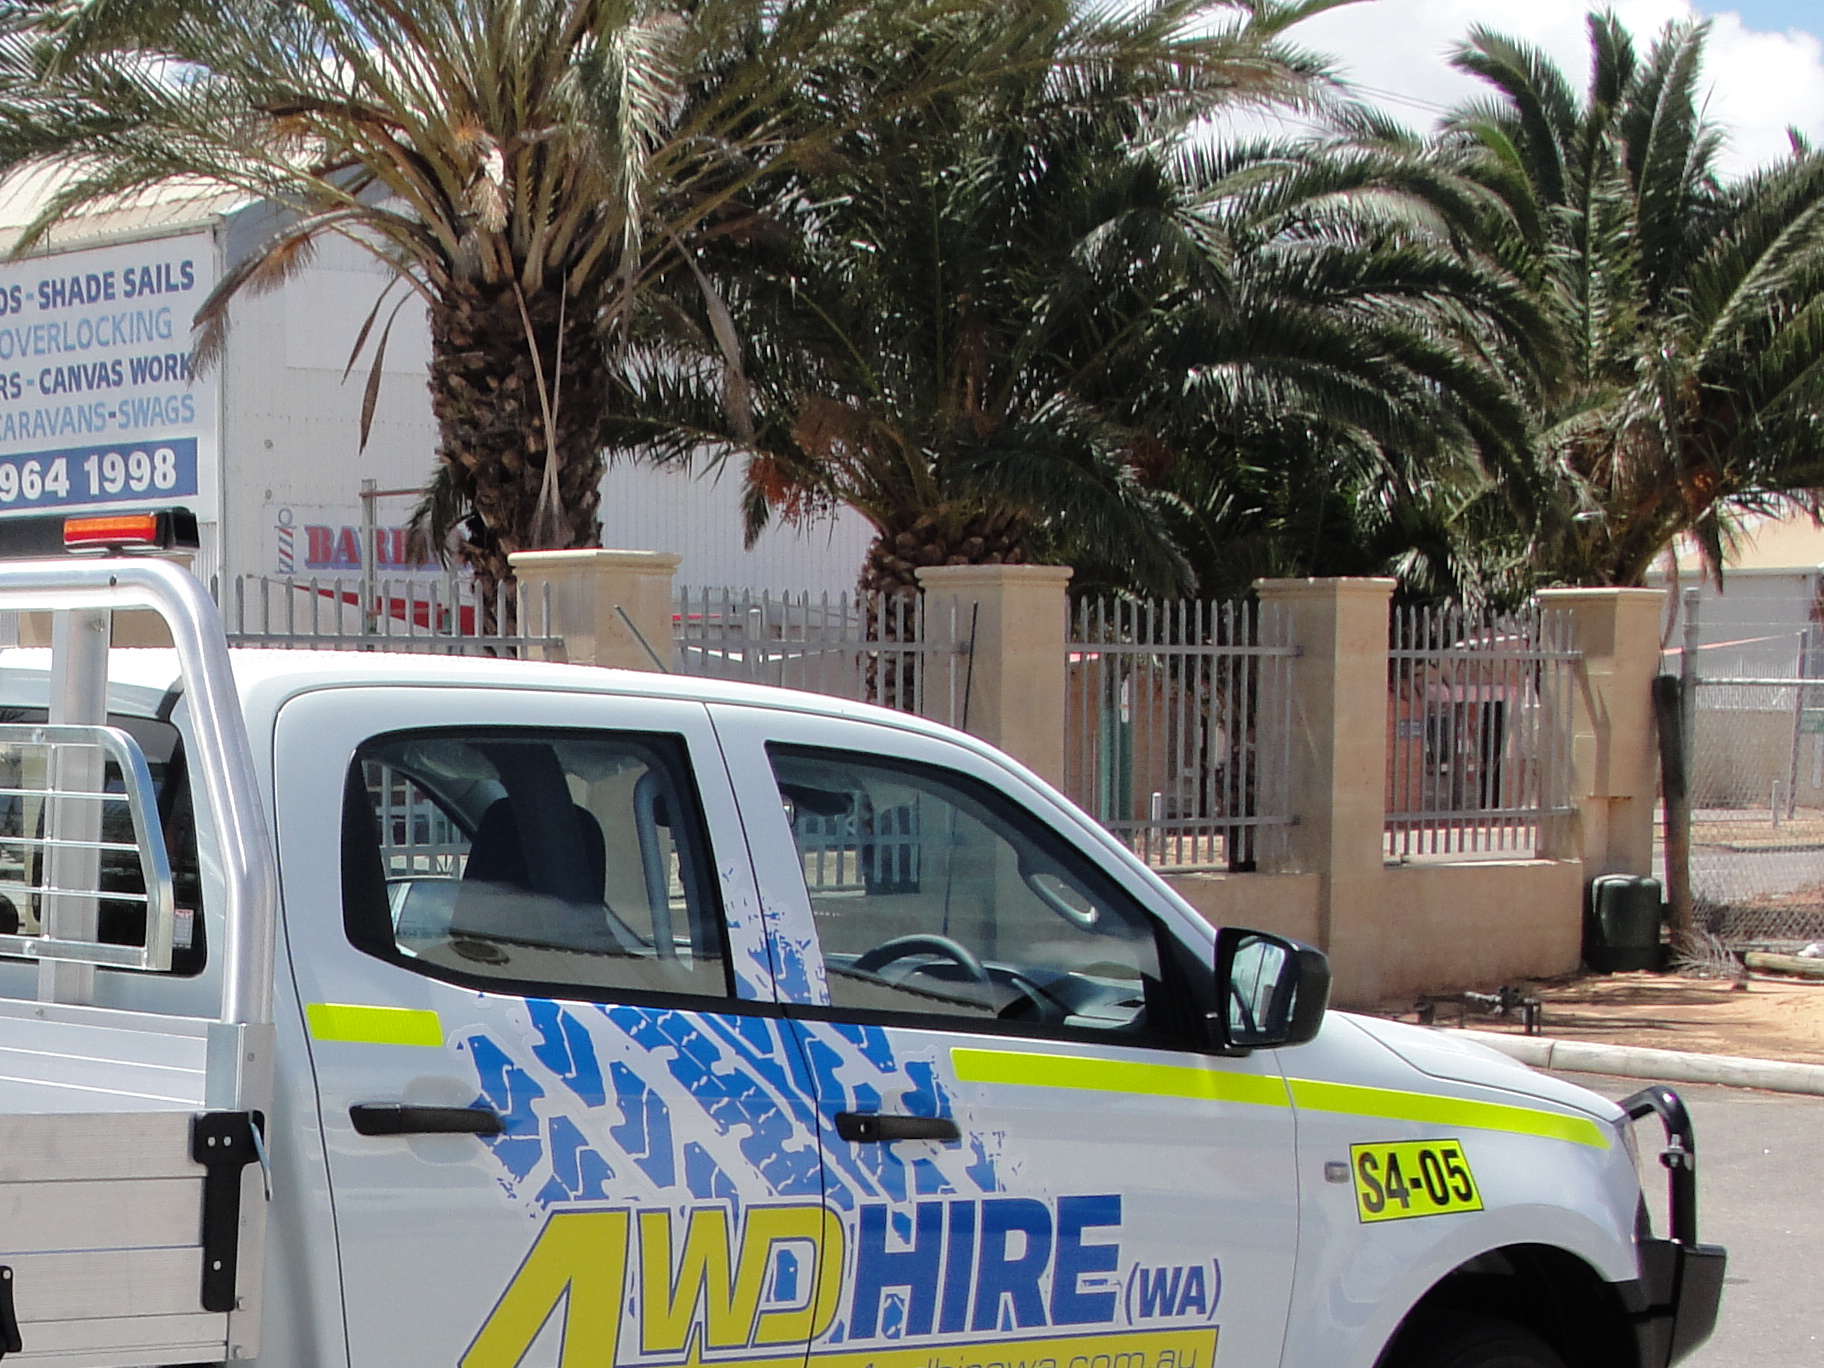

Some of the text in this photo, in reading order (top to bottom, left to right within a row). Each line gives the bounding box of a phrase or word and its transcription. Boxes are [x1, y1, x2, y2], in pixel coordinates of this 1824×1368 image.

[123, 260, 194, 298] SAILS
[84, 448, 176, 496] 1998
[1358, 1149, 1473, 1213] S4-05
[1124, 1258, 1222, 1327] (WA)
